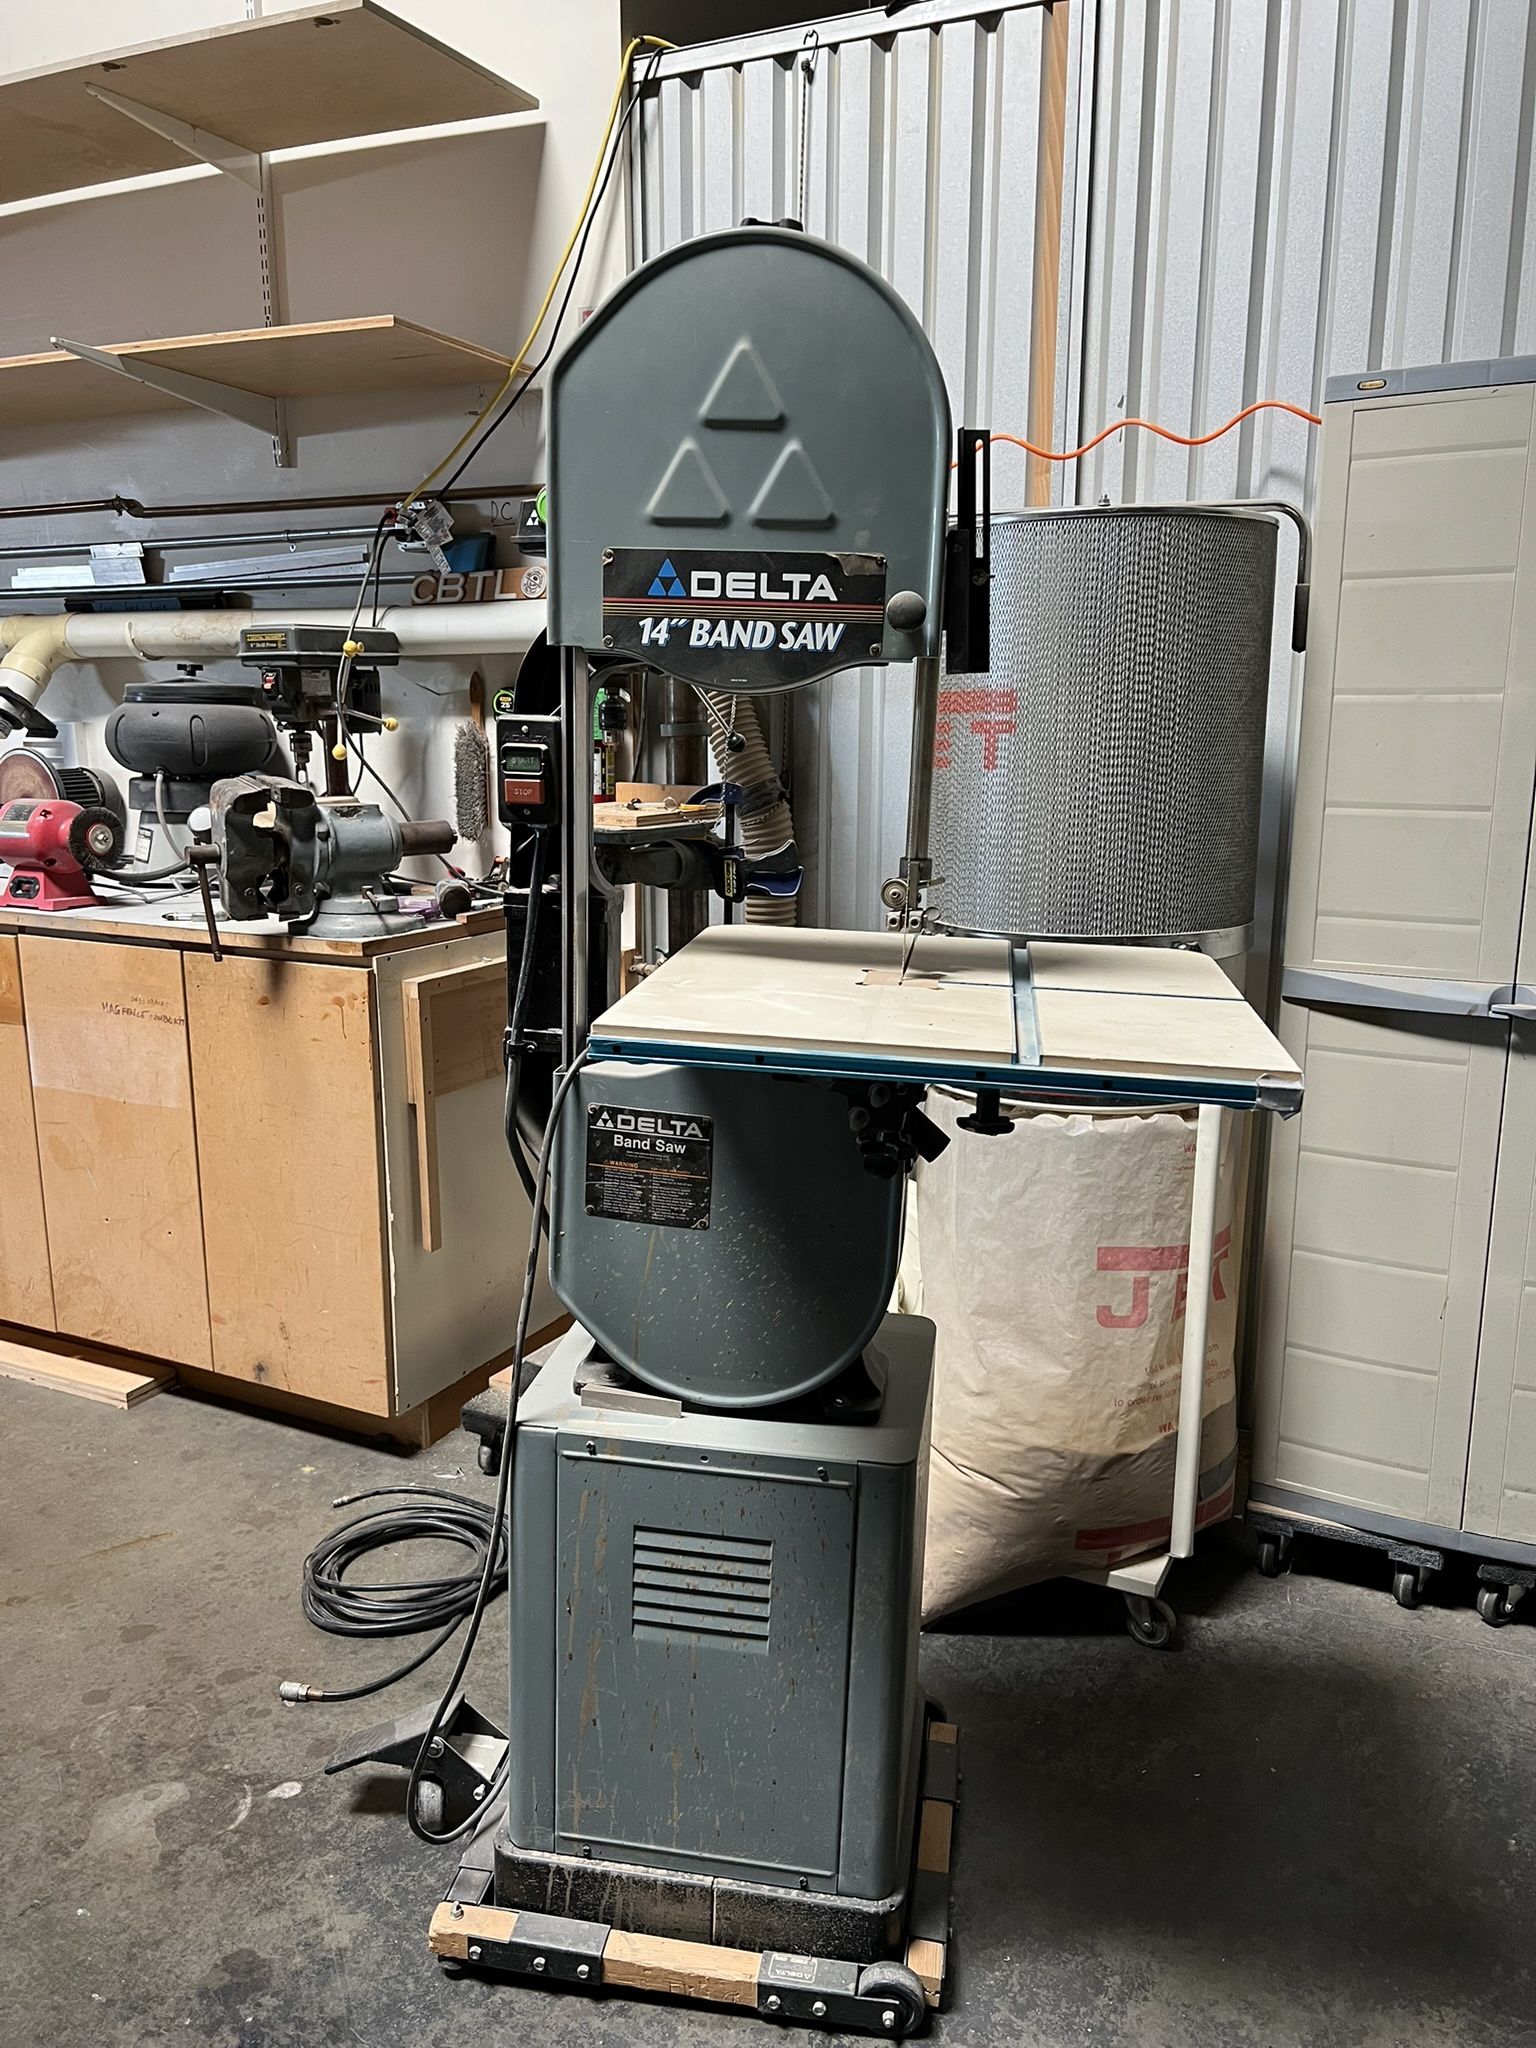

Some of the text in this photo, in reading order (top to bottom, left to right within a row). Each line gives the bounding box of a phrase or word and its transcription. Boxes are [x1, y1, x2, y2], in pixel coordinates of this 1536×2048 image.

[490, 501, 513, 523] DC
[411, 569, 517, 604] CBTL
[691, 571, 838, 602] DELTA
[638, 617, 847, 652] 14" BAND SAW
[512, 757, 534, 765] START
[514, 788, 532, 796] STOP
[617, 1114, 703, 1138] DELTA
[613, 1134, 651, 1150] Band
[655, 1139, 687, 1155] Saw
[609, 1160, 639, 1168] WARNING
